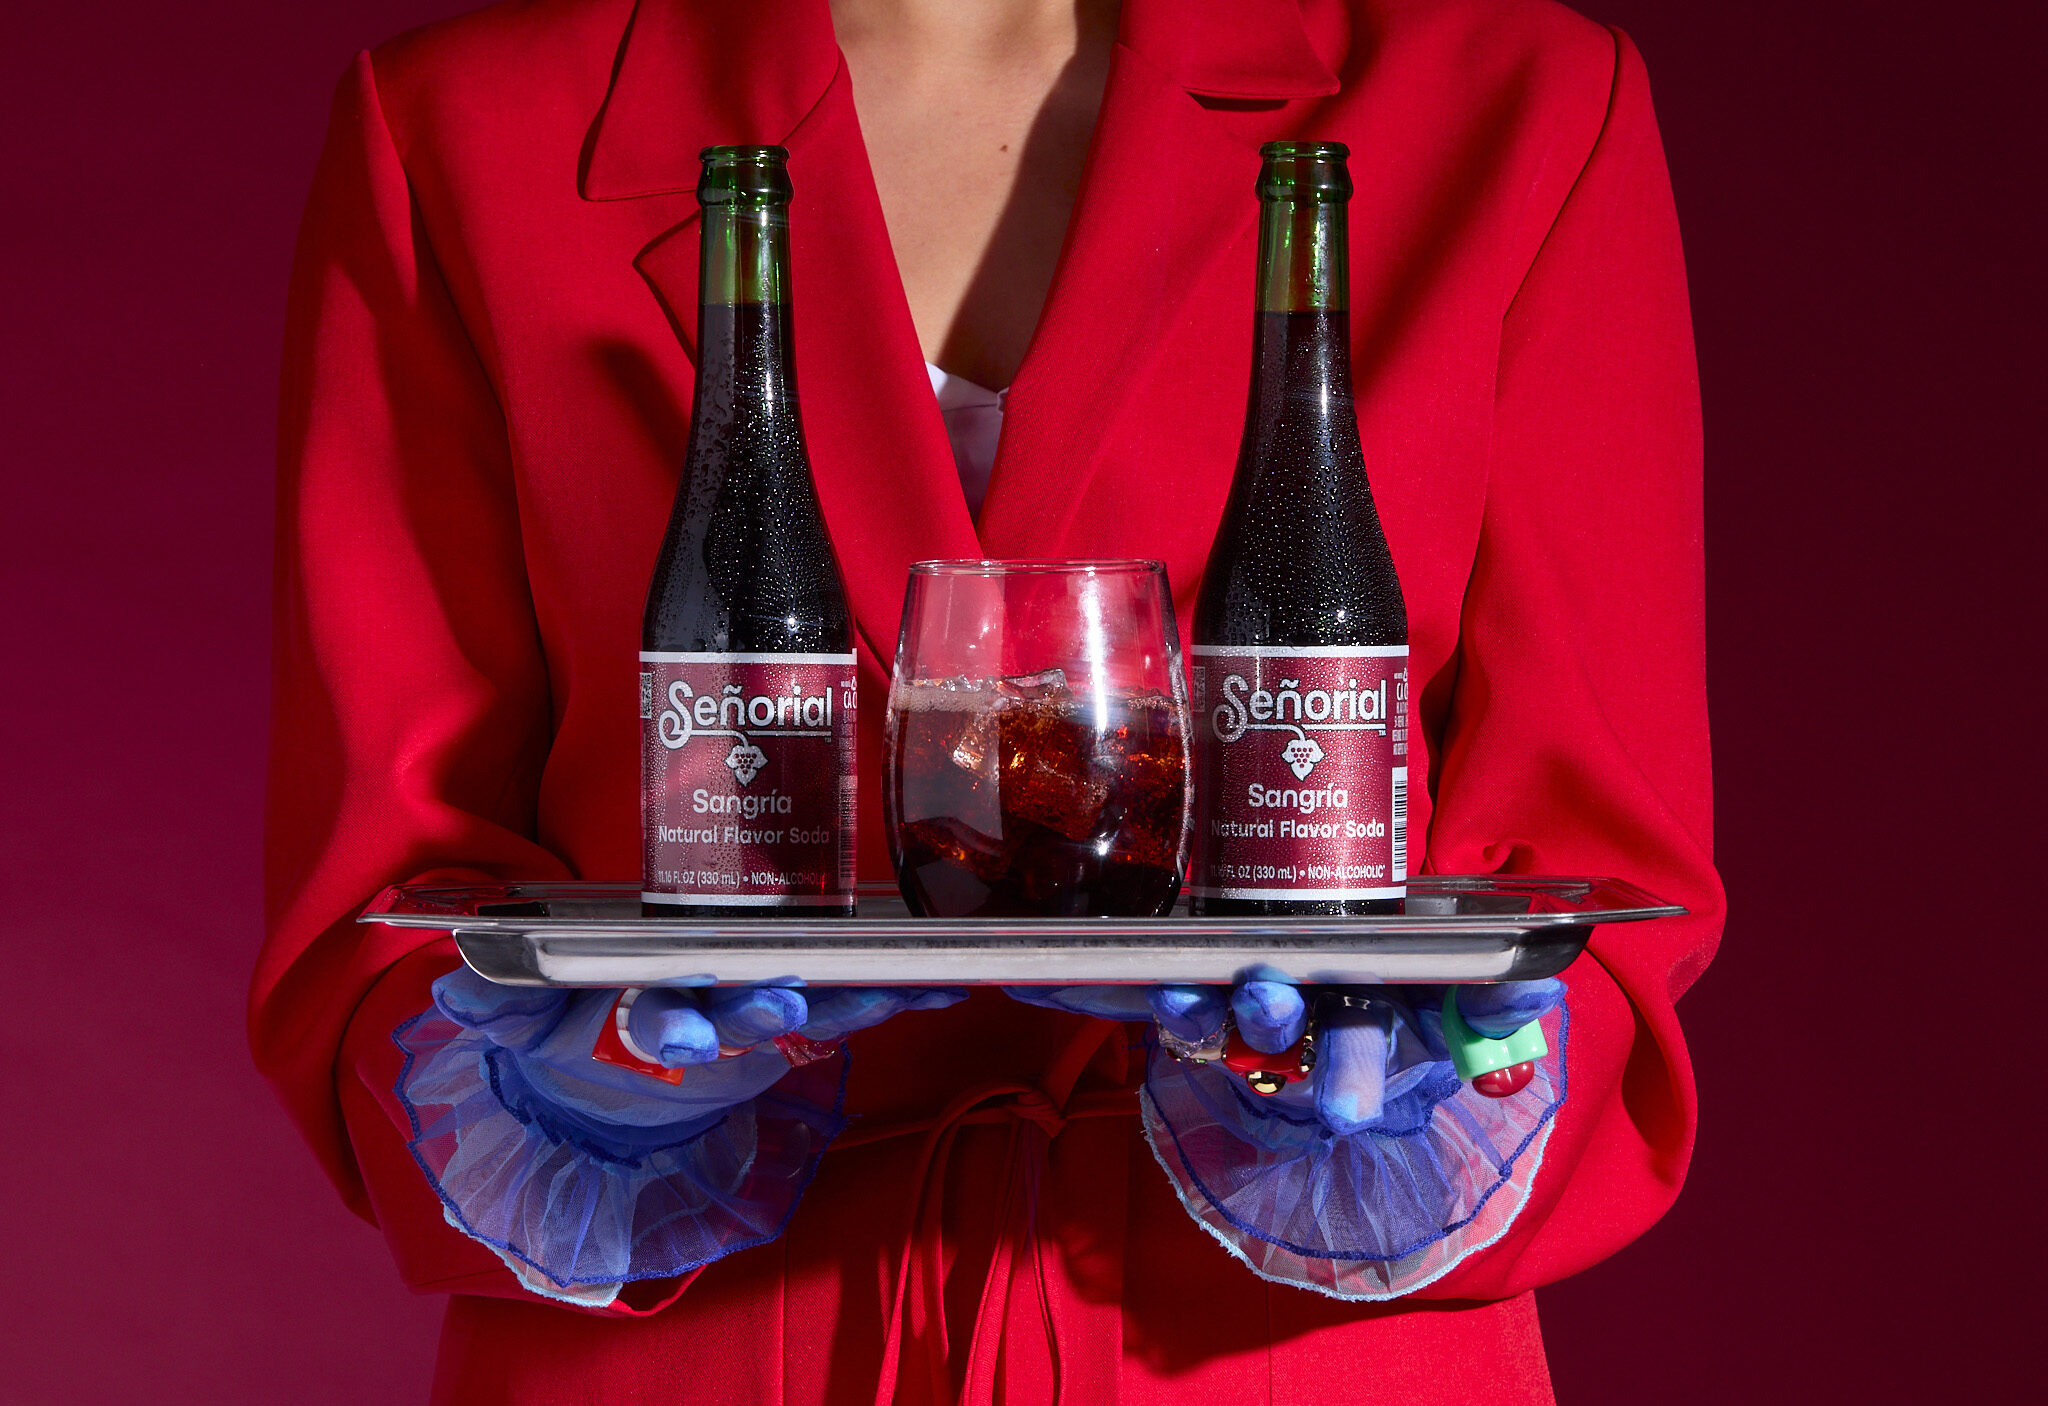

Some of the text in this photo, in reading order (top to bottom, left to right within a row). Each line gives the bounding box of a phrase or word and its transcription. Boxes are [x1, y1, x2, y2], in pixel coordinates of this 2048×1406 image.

[658, 679, 832, 750] Señorial
[1212, 673, 1386, 743] Señorial
[692, 788, 792, 820] Sangría
[1248, 783, 1348, 815] Sangría
[658, 825, 830, 844] Natural Flavor Soda
[1212, 819, 1385, 839] Natural Flavor Soda
[682, 871, 695, 884] OZ
[697, 870, 719, 888] (330
[721, 871, 740, 888] mL)
[1238, 865, 1251, 879] OZ
[1253, 864, 1275, 883] (330
[1278, 864, 1296, 883] mL)
